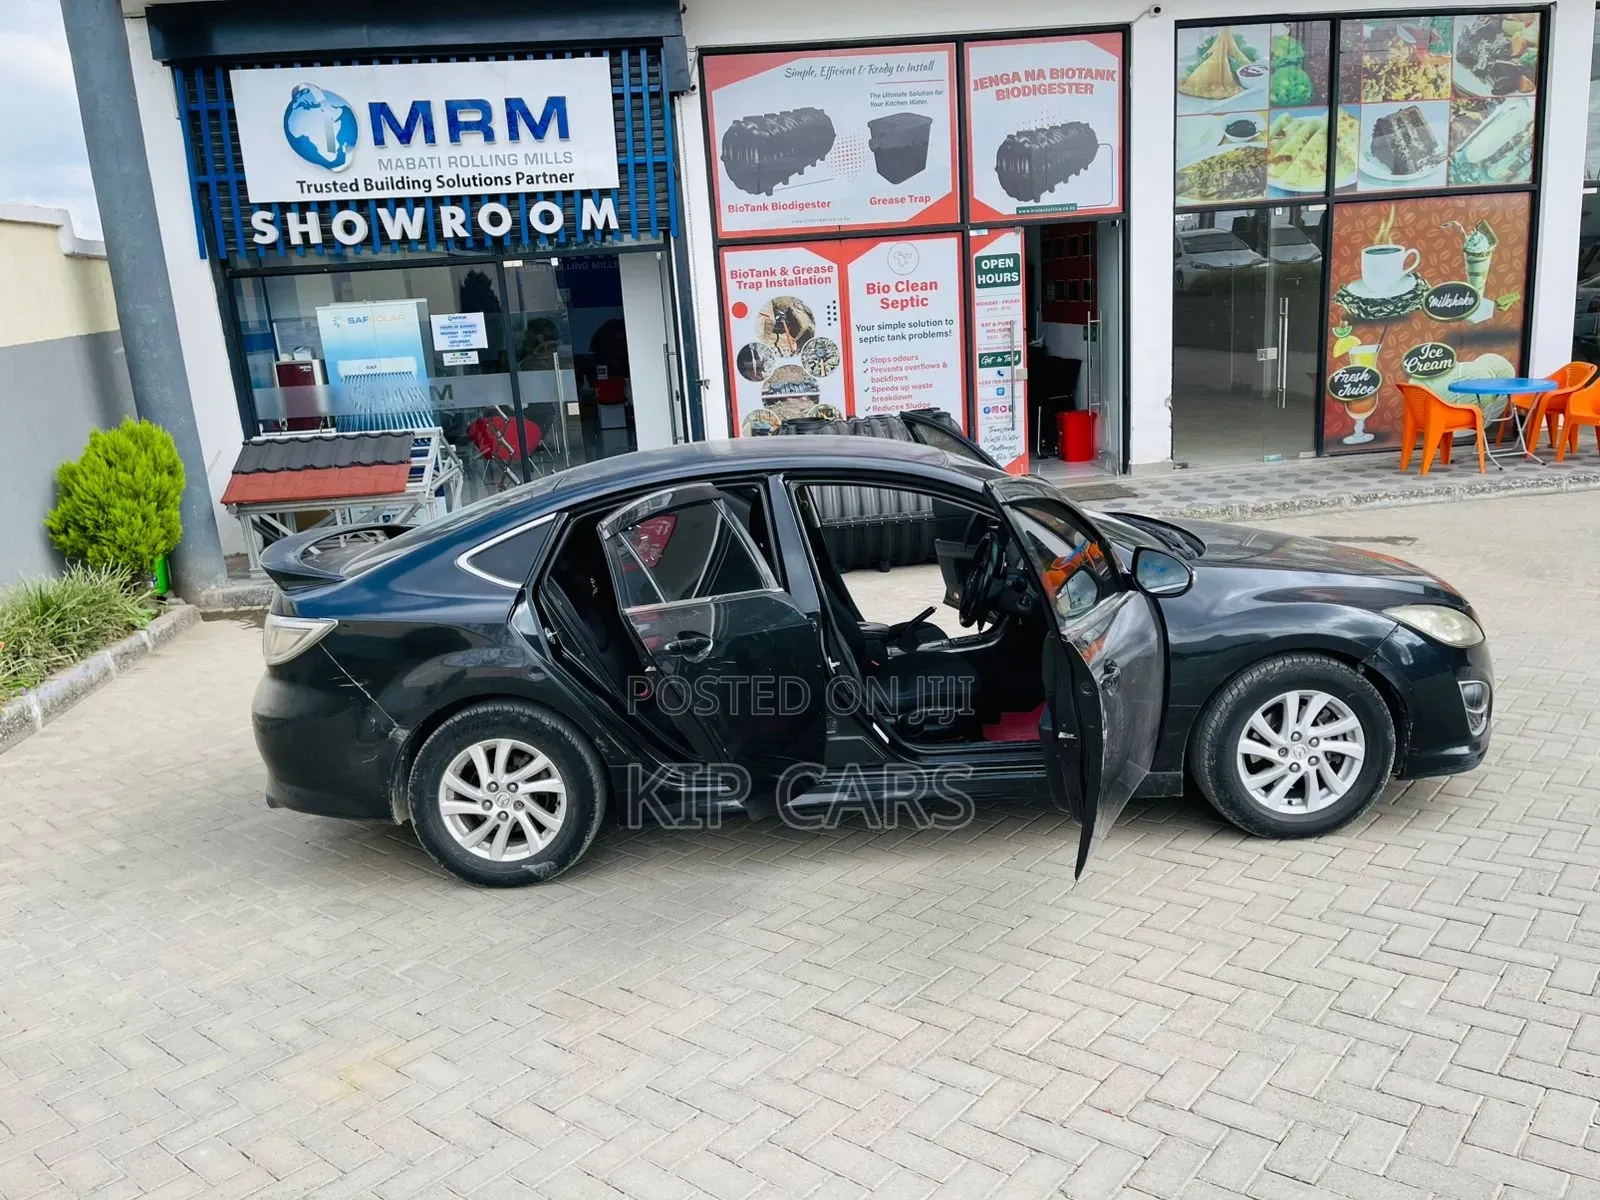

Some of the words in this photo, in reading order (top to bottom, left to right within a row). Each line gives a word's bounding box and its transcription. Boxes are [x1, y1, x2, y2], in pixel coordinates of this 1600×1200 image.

[784, 65, 817, 81] Simple,
[820, 65, 856, 80] Efficient
[868, 62, 894, 77] Ready
[896, 63, 905, 73] to
[907, 60, 936, 73] Install
[972, 71, 1022, 91] JENGA
[1024, 68, 1047, 81] NA
[1049, 67, 1117, 82] BIOTANK
[882, 91, 908, 99] Ultimate
[909, 89, 934, 97] Solution
[995, 82, 1094, 101] BIODIGESTER
[368, 95, 570, 148] MRM
[377, 155, 442, 172] MABATI
[448, 153, 519, 169] ROLLING
[524, 151, 574, 166] MILLS
[296, 177, 360, 194] Trusted
[363, 175, 432, 194] Building
[436, 172, 512, 190] Solutions
[516, 170, 575, 186] Partner
[727, 201, 769, 213] BioTank
[771, 199, 832, 212] Biodigester
[869, 196, 906, 206] Grease
[907, 194, 931, 205] Trap
[251, 196, 620, 247] SHOWROOM
[981, 257, 1014, 270] OPEN
[730, 267, 777, 280] BioTank
[779, 266, 789, 276] &
[792, 264, 834, 276] Grease
[977, 271, 1019, 285] HOURS
[735, 280, 763, 291] Trap
[765, 275, 832, 289] Installation
[866, 282, 891, 295] Bio
[894, 279, 938, 293] Clean
[880, 295, 929, 312] Septic
[1428, 291, 1475, 309] Milkshake
[856, 323, 876, 333] Your
[877, 321, 907, 331] simple
[908, 319, 943, 329] solution
[944, 318, 954, 326] to
[858, 333, 886, 345] septic
[887, 332, 907, 342] tank
[908, 329, 952, 342] problems!
[869, 356, 892, 365] Stops
[893, 354, 919, 362] odours
[1419, 344, 1444, 361] Ice
[870, 365, 903, 374] Prevents
[904, 362, 941, 372] overflows
[941, 361, 948, 369] &
[1403, 357, 1454, 374] Cream
[871, 375, 908, 384] backflows
[1334, 368, 1372, 383] Fresh
[871, 385, 899, 394] Speeds
[911, 382, 934, 390] waste
[1338, 383, 1376, 397] Juice
[872, 394, 913, 403] breakdown
[872, 404, 904, 412] Reduces
[905, 402, 932, 410] Sludge
